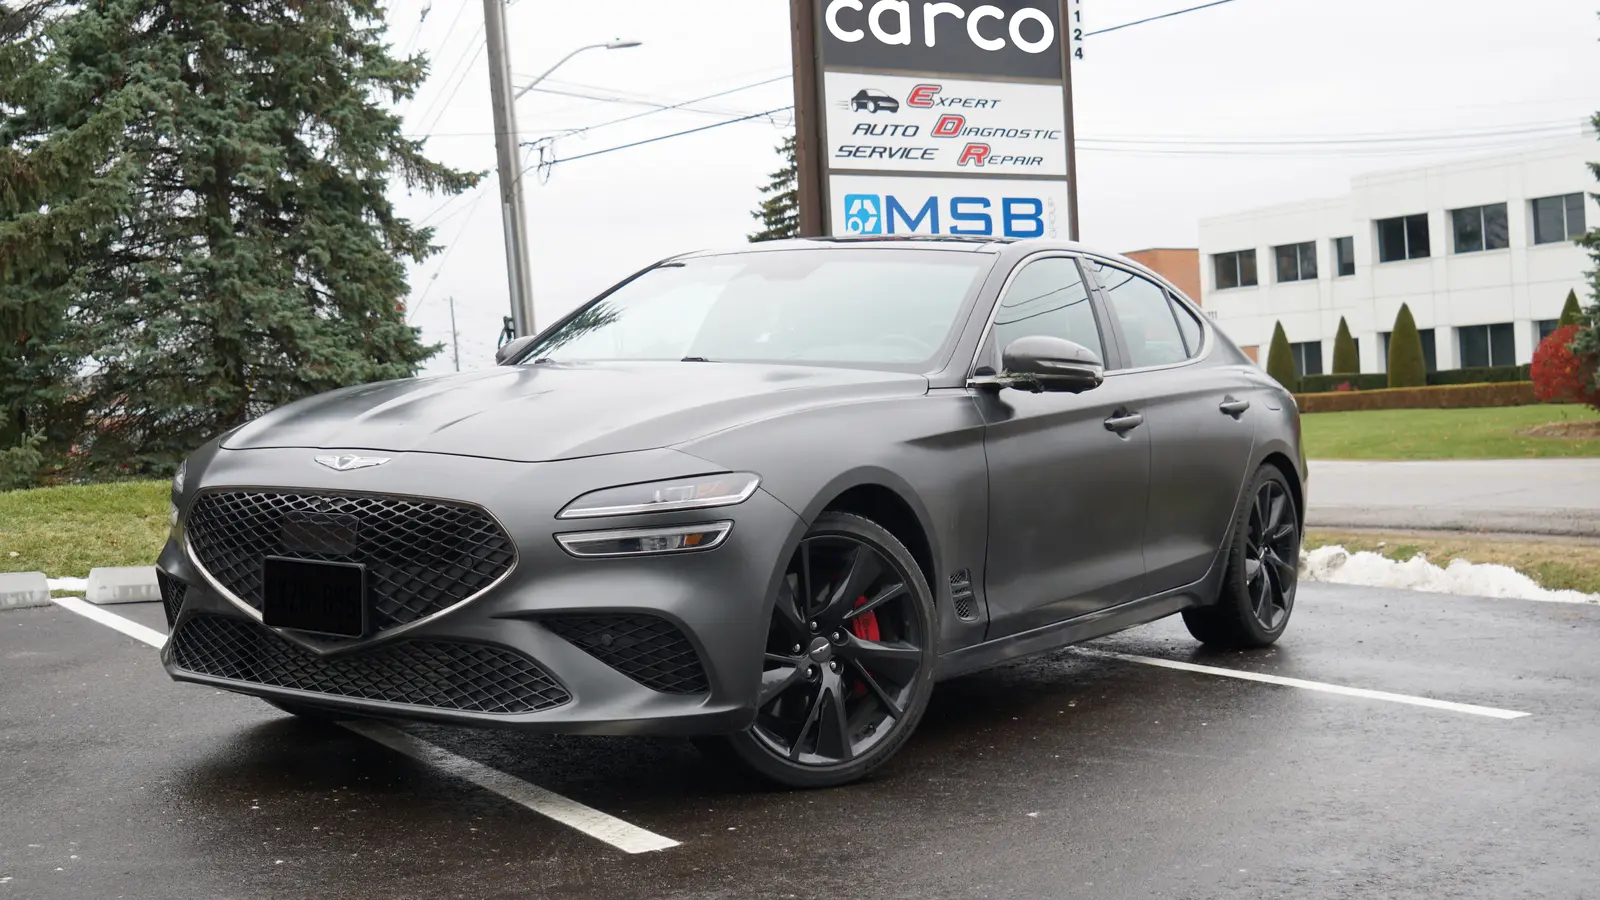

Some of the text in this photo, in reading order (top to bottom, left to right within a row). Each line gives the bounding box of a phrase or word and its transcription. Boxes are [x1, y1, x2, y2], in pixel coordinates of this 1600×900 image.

[825, 0, 1055, 53] carco
[1074, 0, 1083, 59] 124
[906, 84, 1001, 108] EXPERT
[852, 114, 1062, 140] AUTO DIAGNOSTIC
[835, 142, 1044, 167] SERVICE REPAIR
[885, 195, 1044, 238] MSB
